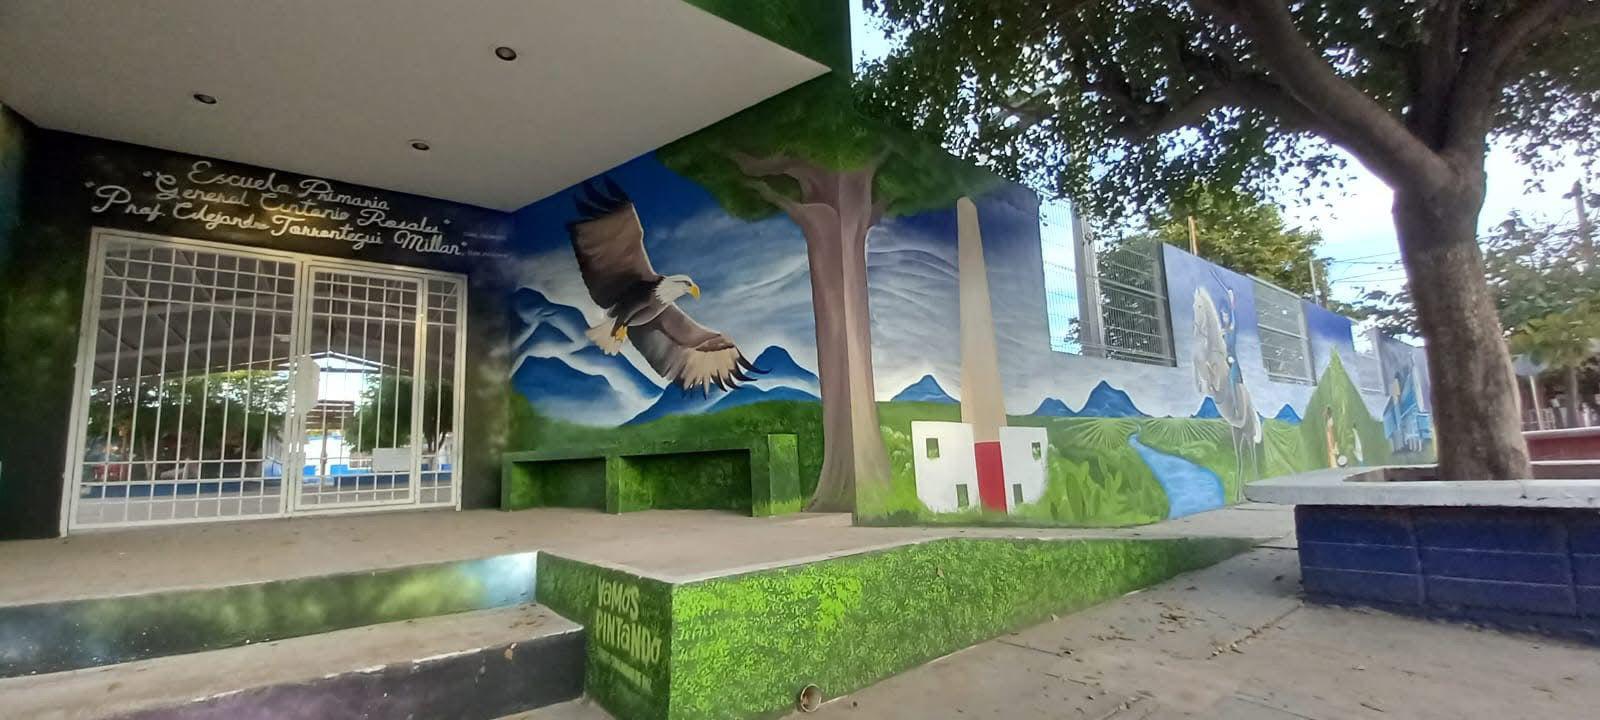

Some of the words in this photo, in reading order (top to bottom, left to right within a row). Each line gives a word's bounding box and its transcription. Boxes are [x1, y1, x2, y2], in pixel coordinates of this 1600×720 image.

[188, 161, 291, 194] Escuela
[298, 179, 390, 210] Primaria
[271, 214, 384, 250] Torrontegui
